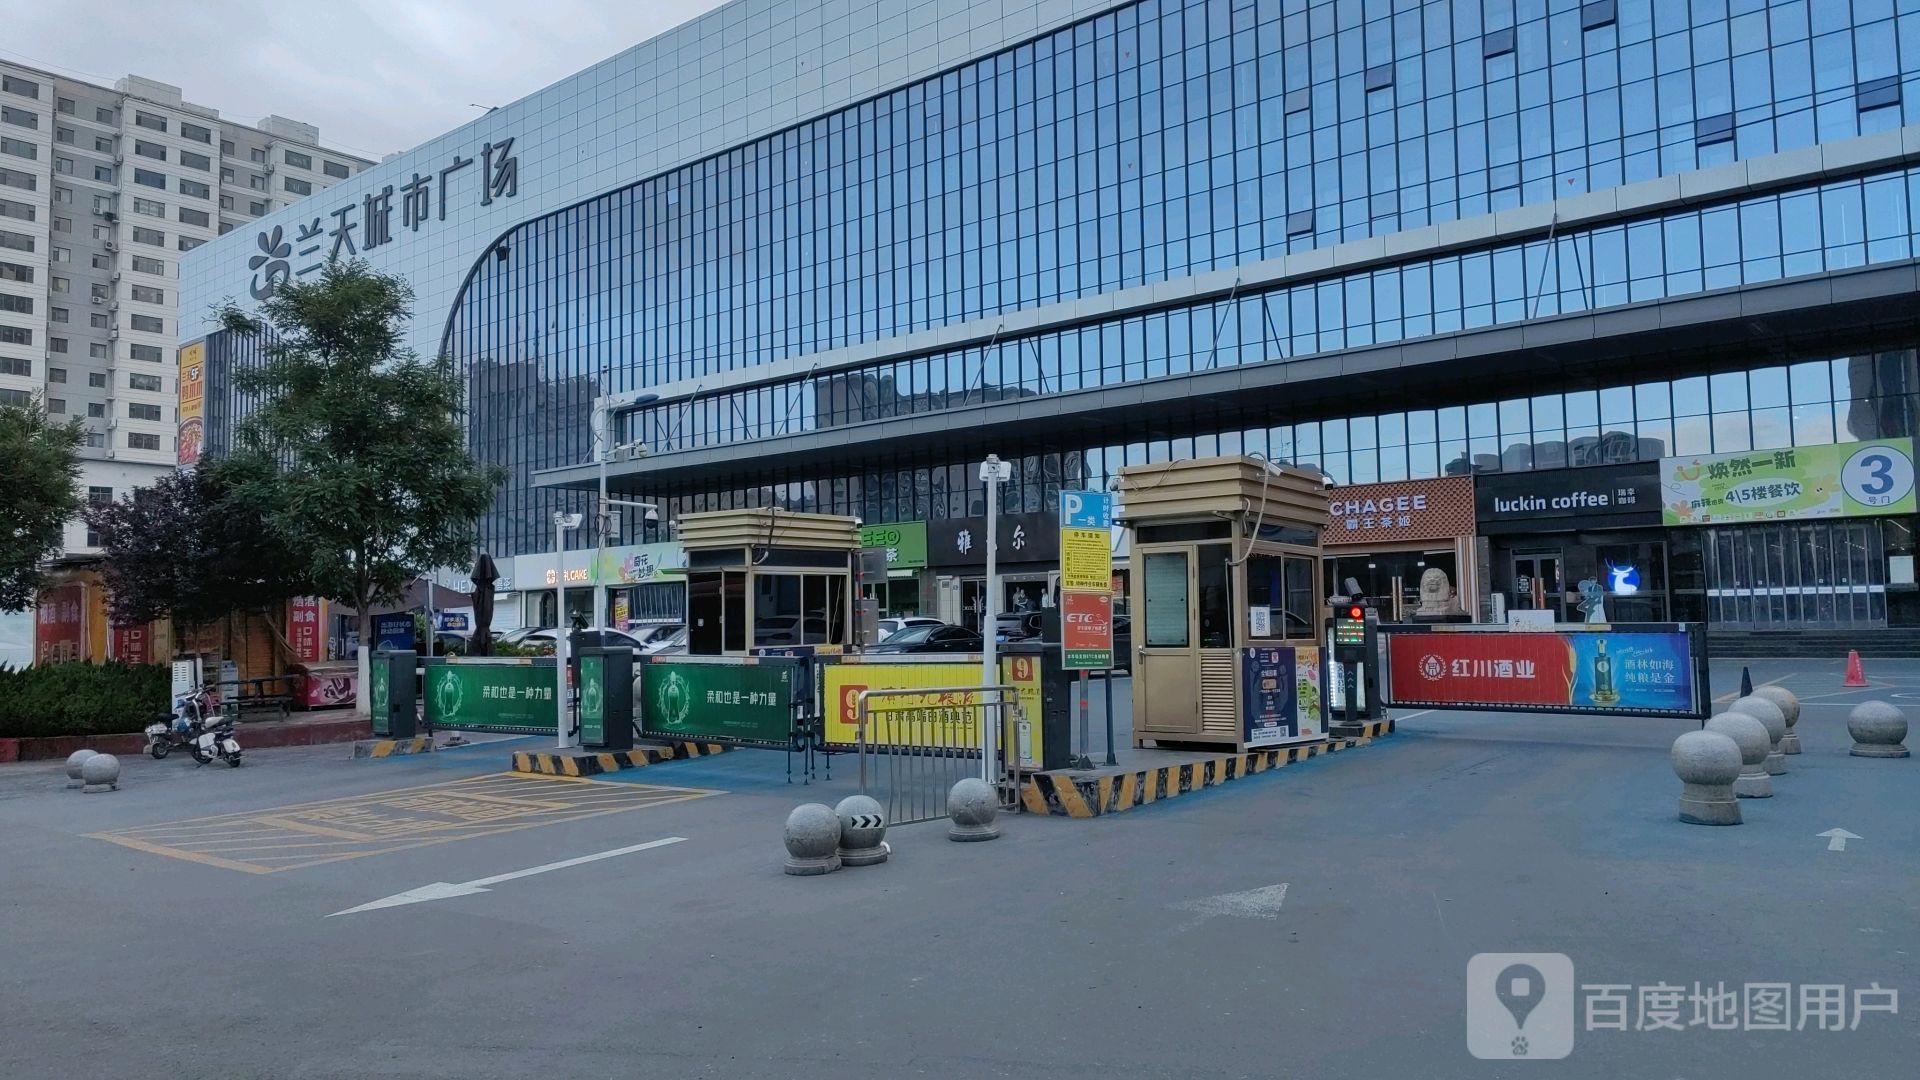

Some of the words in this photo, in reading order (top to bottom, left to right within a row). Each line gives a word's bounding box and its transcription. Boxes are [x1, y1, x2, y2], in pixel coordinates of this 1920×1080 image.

[296, 136, 517, 276] 兰天城市广场
[1707, 450, 1796, 480] 焕然一新
[1860, 454, 1894, 495] 3
[1617, 488, 1635, 496] 瑞幸
[1725, 482, 1800, 503] 4\5楼餐饮
[1330, 494, 1427, 516] CHAGEE
[1495, 495, 1547, 513] luckin
[1552, 491, 1609, 509] coffee
[1618, 496, 1636, 505] 咖啡
[1867, 496, 1891, 505] 号门
[1065, 494, 1082, 525] P
[1077, 515, 1096, 526] 一类
[1345, 515, 1411, 530] 霸王茶姬
[957, 525, 1025, 555] 雅尔
[293, 610, 316, 623] 副食
[1451, 658, 1536, 679] 红川酒业
[1624, 659, 1675, 671] 酒林如海
[1625, 671, 1675, 684] 纯粮是金
[482, 685, 552, 700] 柔和也是一种力量
[706, 690, 777, 706] 柔和也是一种力量
